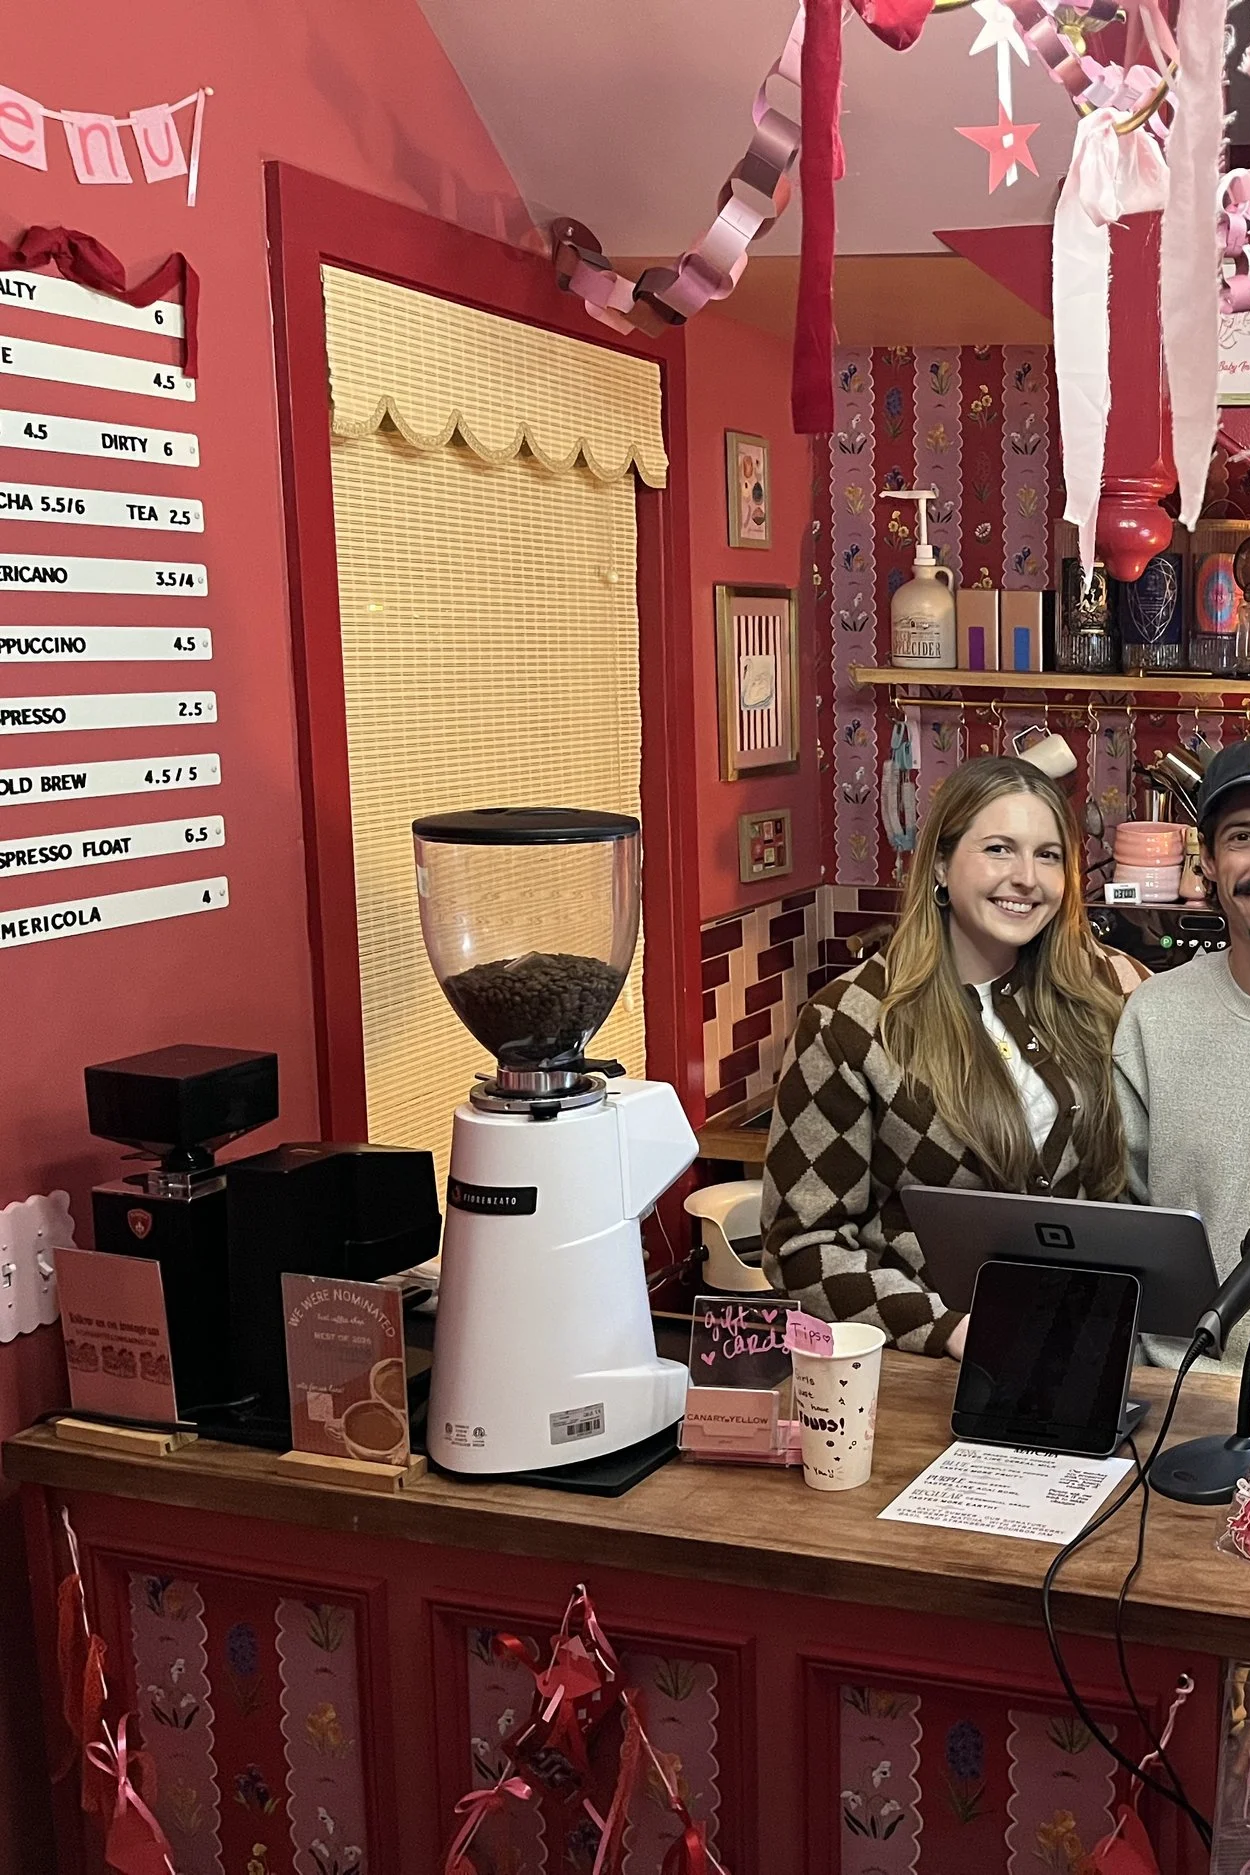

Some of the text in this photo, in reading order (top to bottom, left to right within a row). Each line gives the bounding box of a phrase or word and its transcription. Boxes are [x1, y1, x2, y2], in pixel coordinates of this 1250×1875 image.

[155, 310, 163, 325] 6
[153, 372, 175, 390] 4.5
[23, 422, 173, 456] 4.5 DIRTY 6
[126, 503, 158, 521] TEA
[169, 509, 191, 526] 2.5
[173, 636, 196, 651] 4.5
[178, 702, 203, 717] 2.5
[41, 773, 87, 792] BREW
[82, 826, 208, 858] FLOAT 6.5
[202, 890, 211, 904] 4
[463, 1193, 517, 1205] FIORENZATO
[288, 1307, 304, 1328] WE
[301, 1289, 330, 1311] WERE
[333, 1288, 397, 1338] NOMINATED
[704, 1305, 750, 1342] gift
[790, 1322, 821, 1346] Tips
[687, 1413, 769, 1425] CANARY YELLOW
